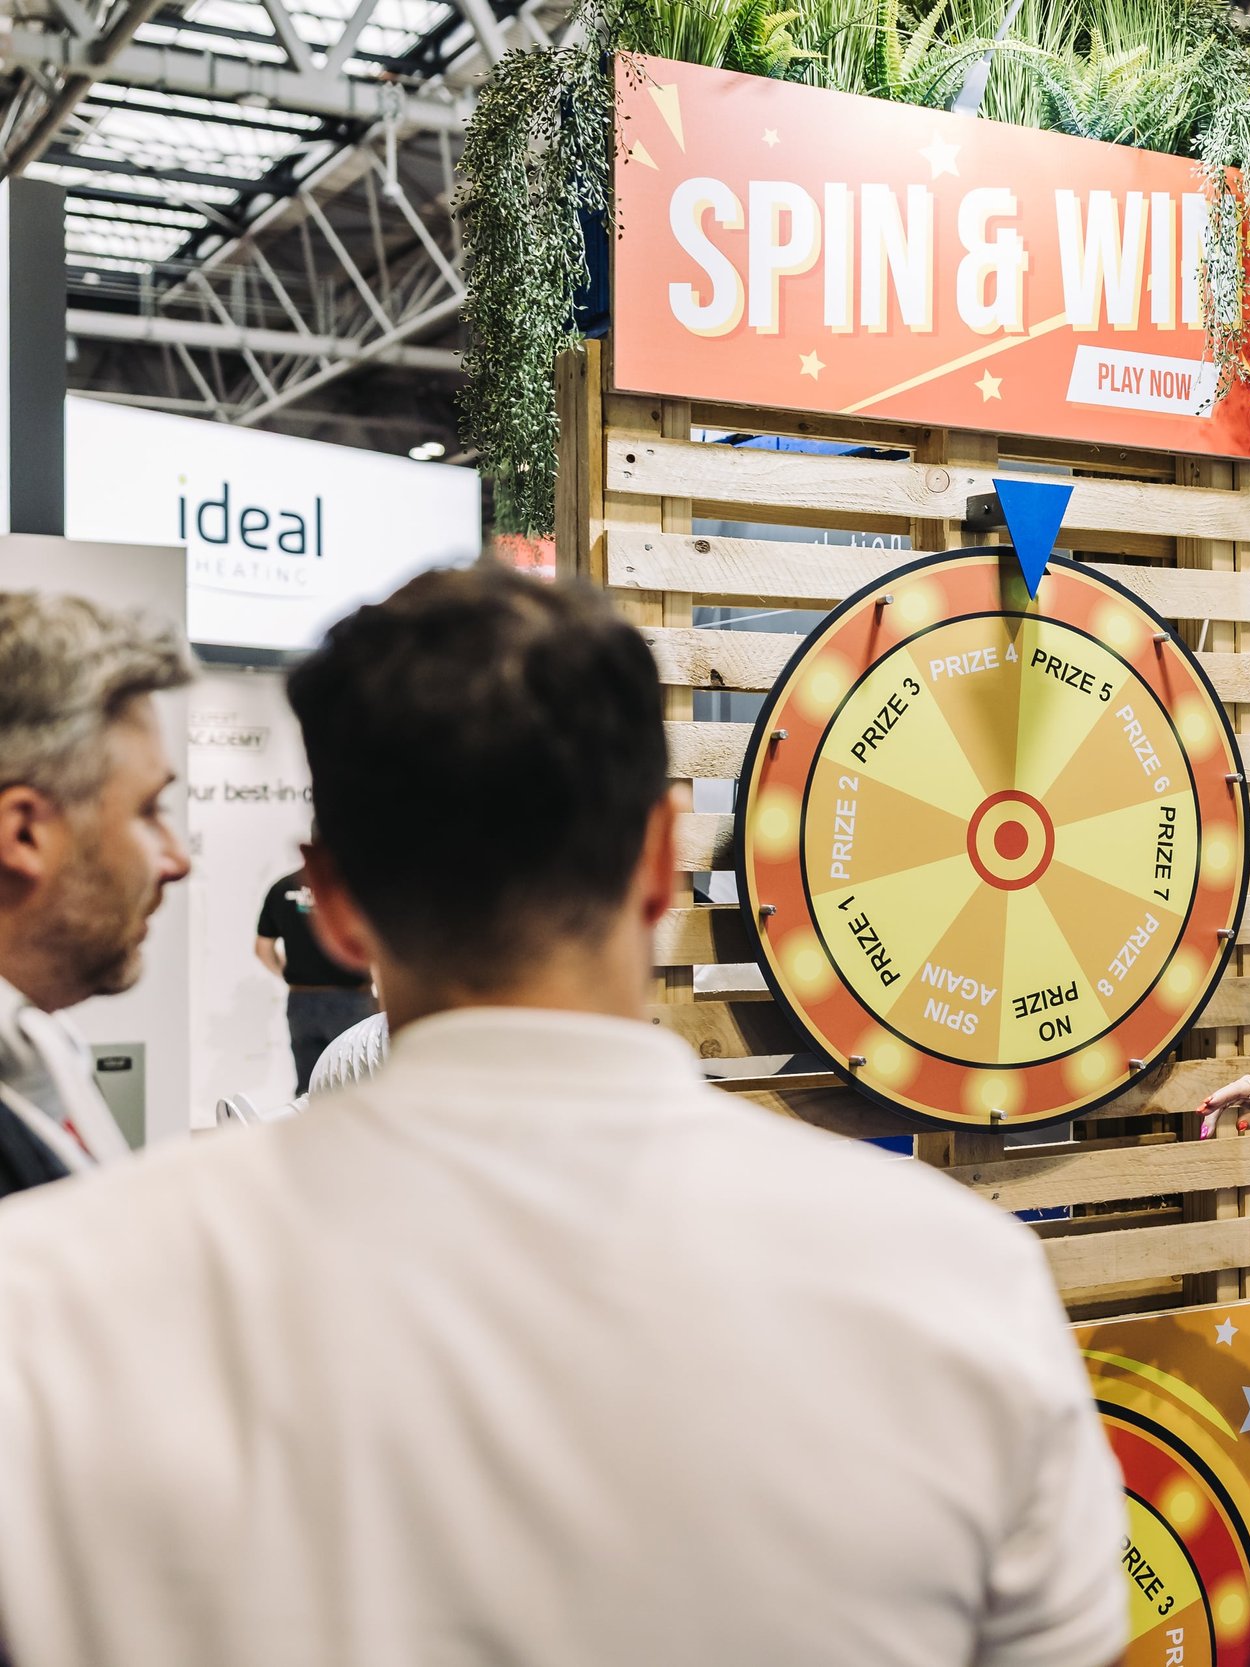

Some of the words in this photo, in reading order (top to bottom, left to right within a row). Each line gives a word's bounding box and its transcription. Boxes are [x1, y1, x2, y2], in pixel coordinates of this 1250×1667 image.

[668, 176, 934, 336] SPIN
[956, 187, 1029, 334] &
[1098, 362, 1144, 395] PLAY
[1150, 369, 1192, 401] NOW
[178, 473, 322, 557] ideal
[929, 649, 999, 682] PRIZE
[1005, 643, 1019, 664] 4
[1030, 648, 1096, 695] PRIZE
[1099, 682, 1114, 702] 5
[851, 692, 908, 764] PRIZE
[902, 677, 921, 696] 3
[1115, 704, 1160, 778] PRIZE
[1154, 775, 1171, 793] 6
[838, 775, 859, 792] 2
[831, 799, 857, 880] PRIZE
[1154, 806, 1176, 880] PRIZE
[837, 895, 856, 911] 1
[1153, 888, 1170, 901] 7
[848, 912, 902, 988] PRIZE
[1109, 913, 1160, 981] PRIZE
[921, 962, 998, 1008] AGAIN
[1012, 981, 1079, 1020] PRIZE
[1097, 977, 1114, 997] 8
[923, 997, 979, 1035] SPIN
[1038, 1014, 1072, 1042] NO
[1158, 1596, 1174, 1616] 3
[1166, 1628, 1184, 1667] PR
